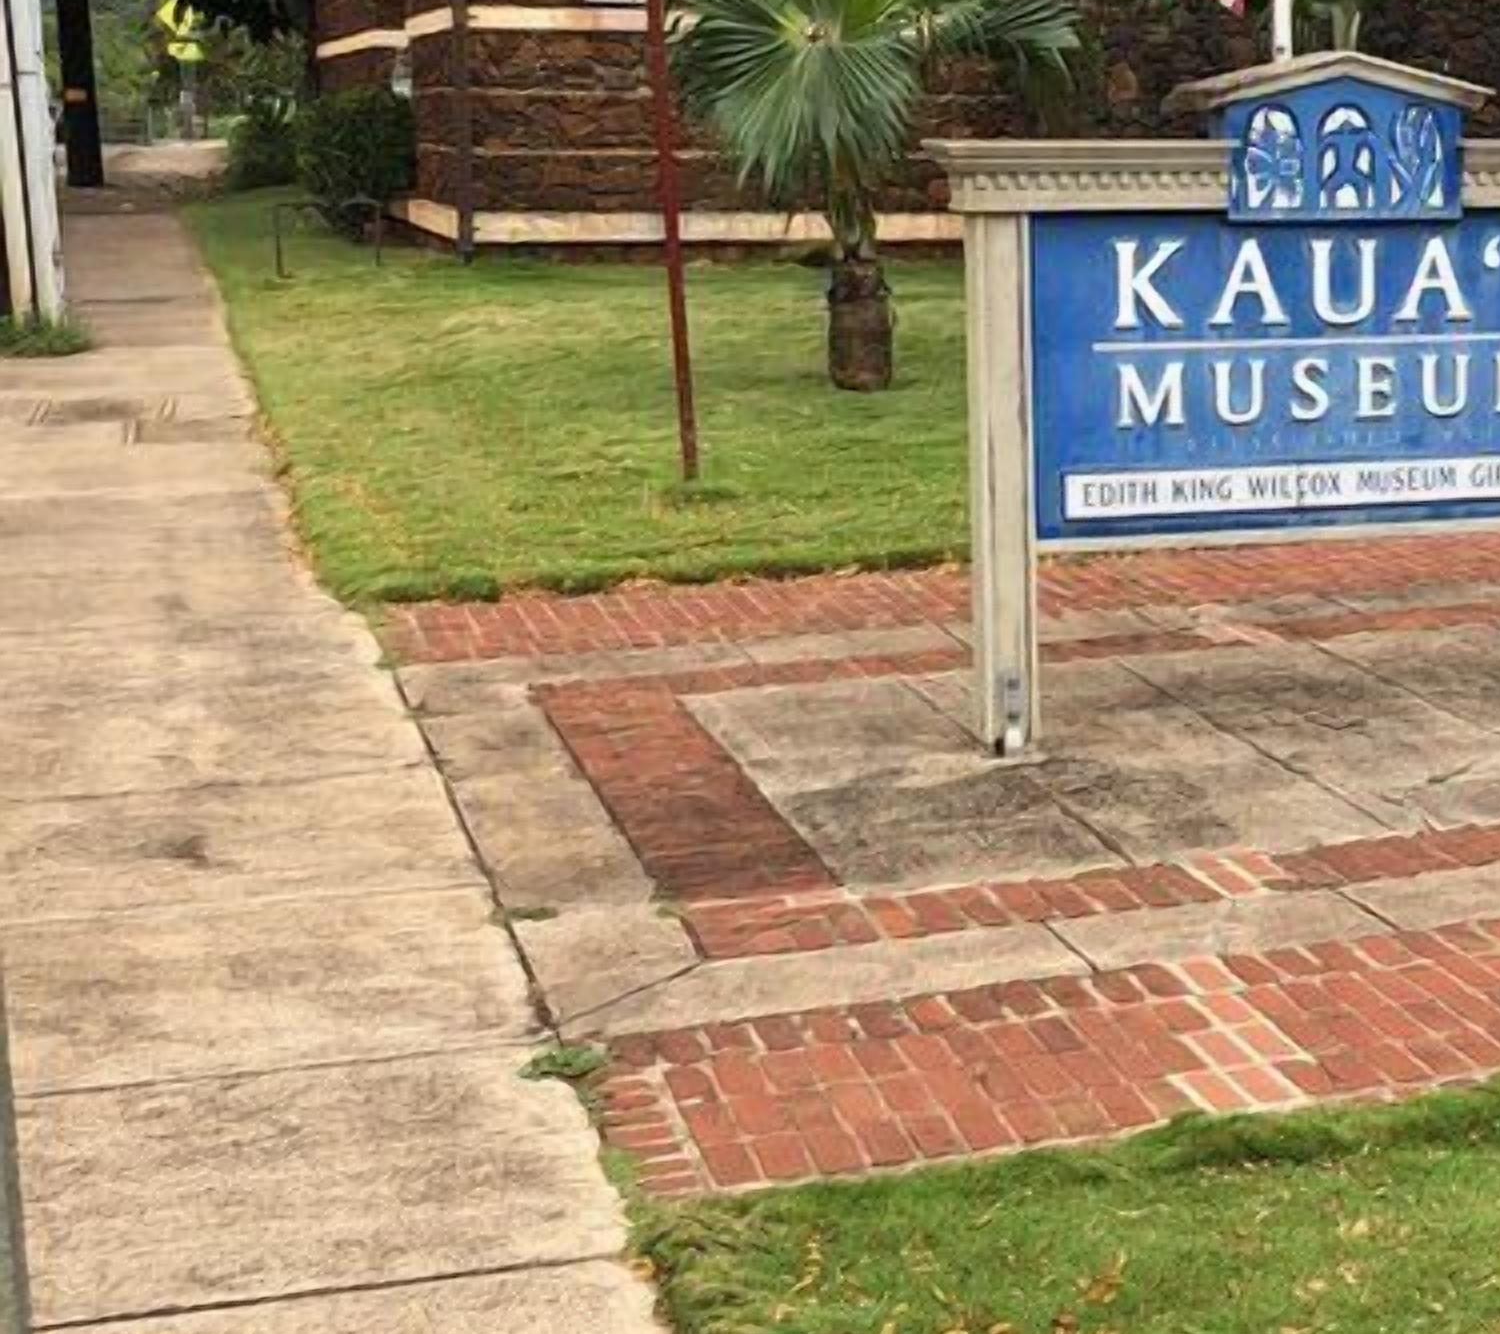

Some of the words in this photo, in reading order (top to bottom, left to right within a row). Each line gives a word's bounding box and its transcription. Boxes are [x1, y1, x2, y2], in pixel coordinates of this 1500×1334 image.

[1083, 480, 1157, 507] EDITH
[1172, 475, 1232, 503] KING
[1249, 471, 1343, 501] WILCOX
[1356, 465, 1457, 495] MUSEUM
